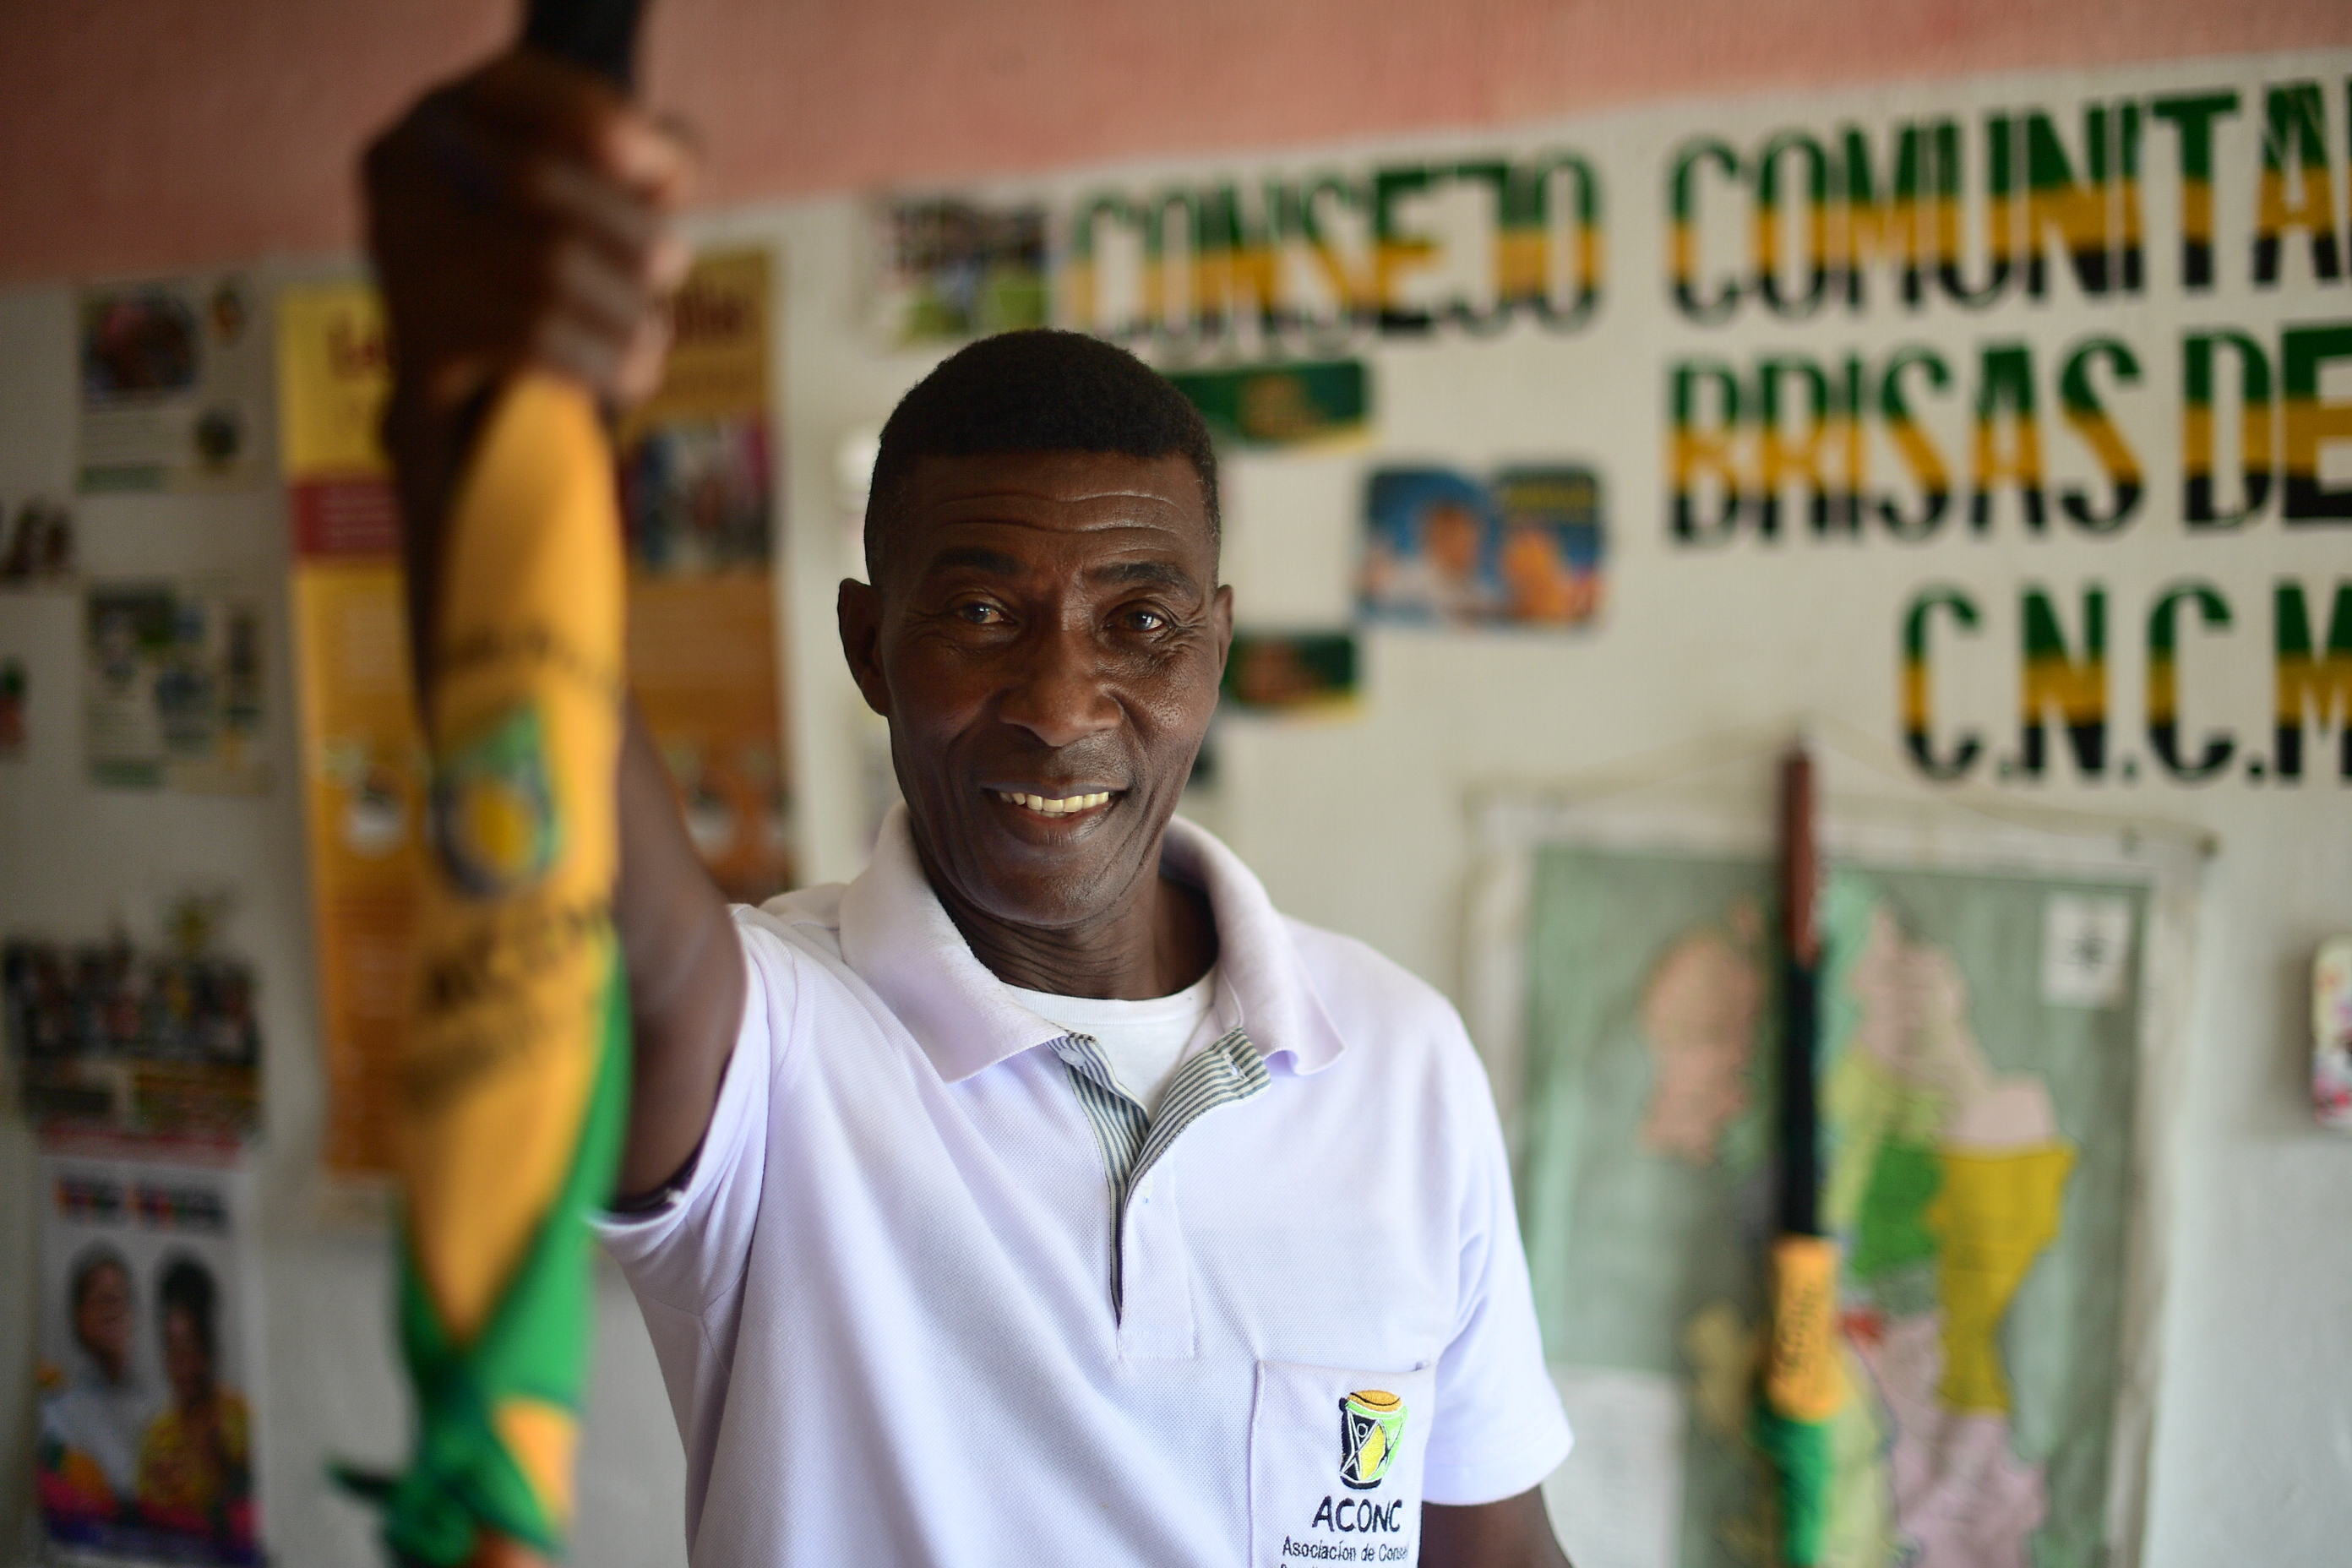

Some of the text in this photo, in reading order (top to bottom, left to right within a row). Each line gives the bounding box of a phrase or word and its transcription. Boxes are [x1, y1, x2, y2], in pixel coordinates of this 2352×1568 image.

[1064, 73, 2352, 357] CONSEJO COMUNITA
[1666, 318, 2352, 545] BRISAS DE
[1311, 1494, 1402, 1533] ACONC
[1360, 1543, 1375, 1562] de
